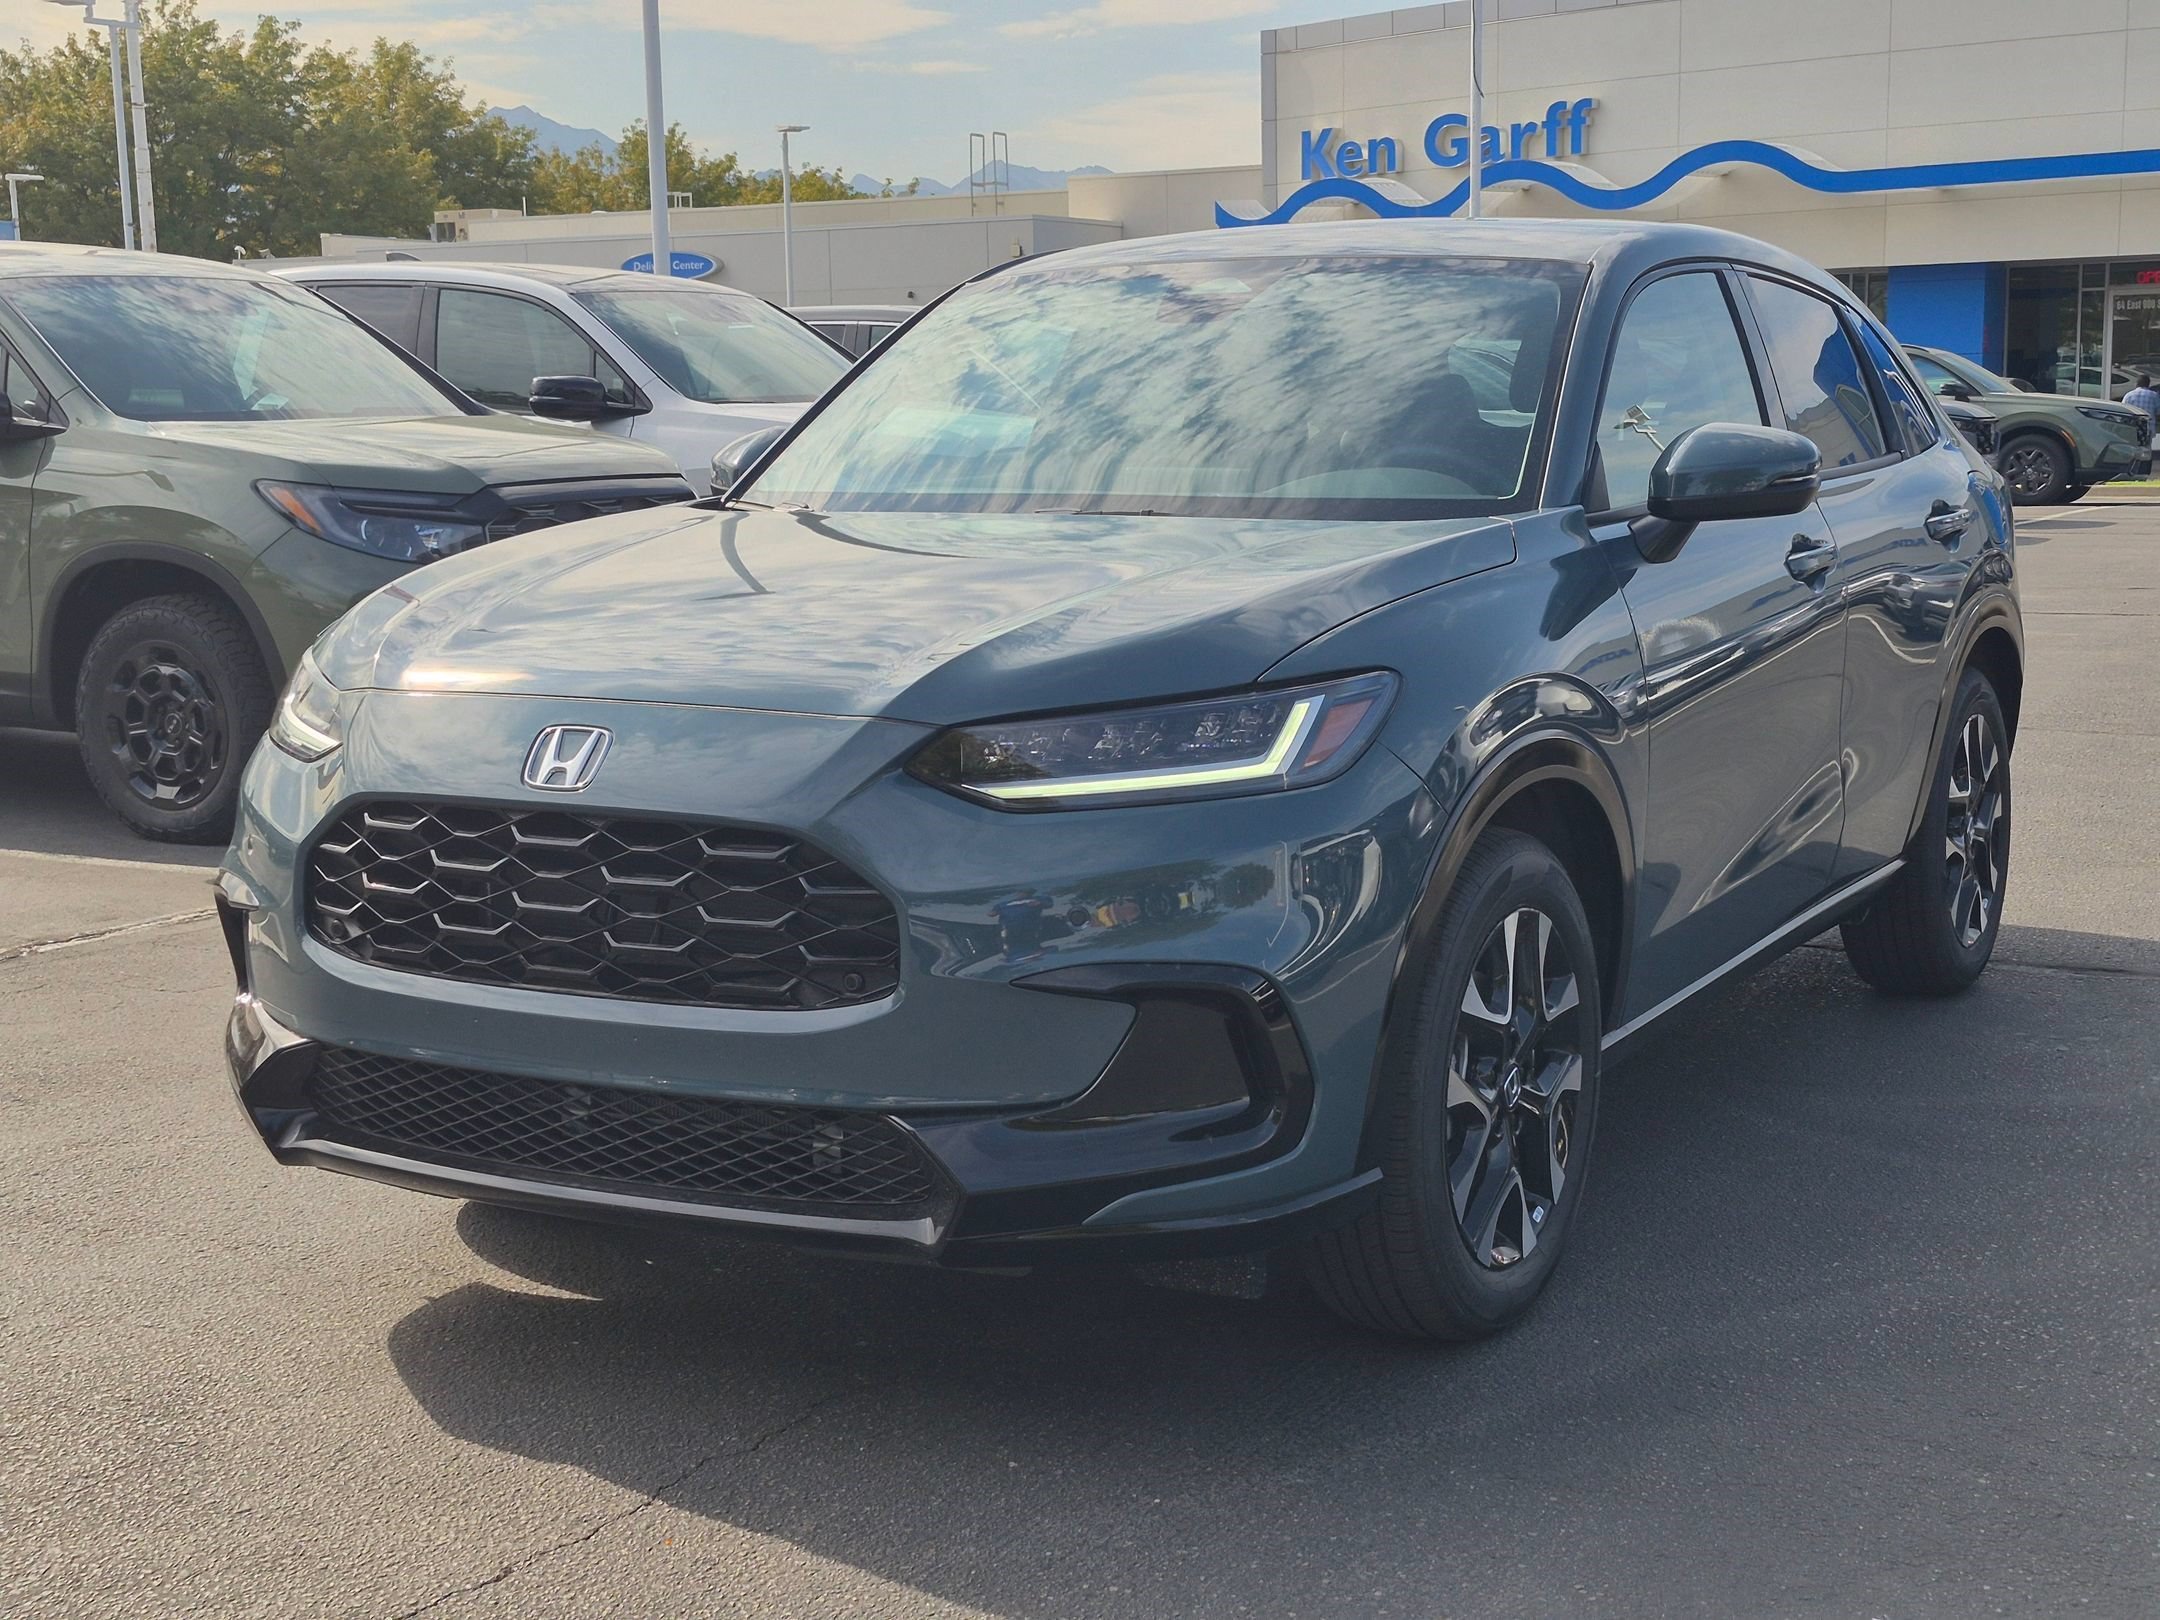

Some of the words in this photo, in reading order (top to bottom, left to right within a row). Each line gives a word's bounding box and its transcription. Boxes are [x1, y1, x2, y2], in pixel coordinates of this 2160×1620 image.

[1301, 127, 1398, 181] Ken
[1424, 97, 1594, 168] Garff
[672, 261, 704, 270] Center
